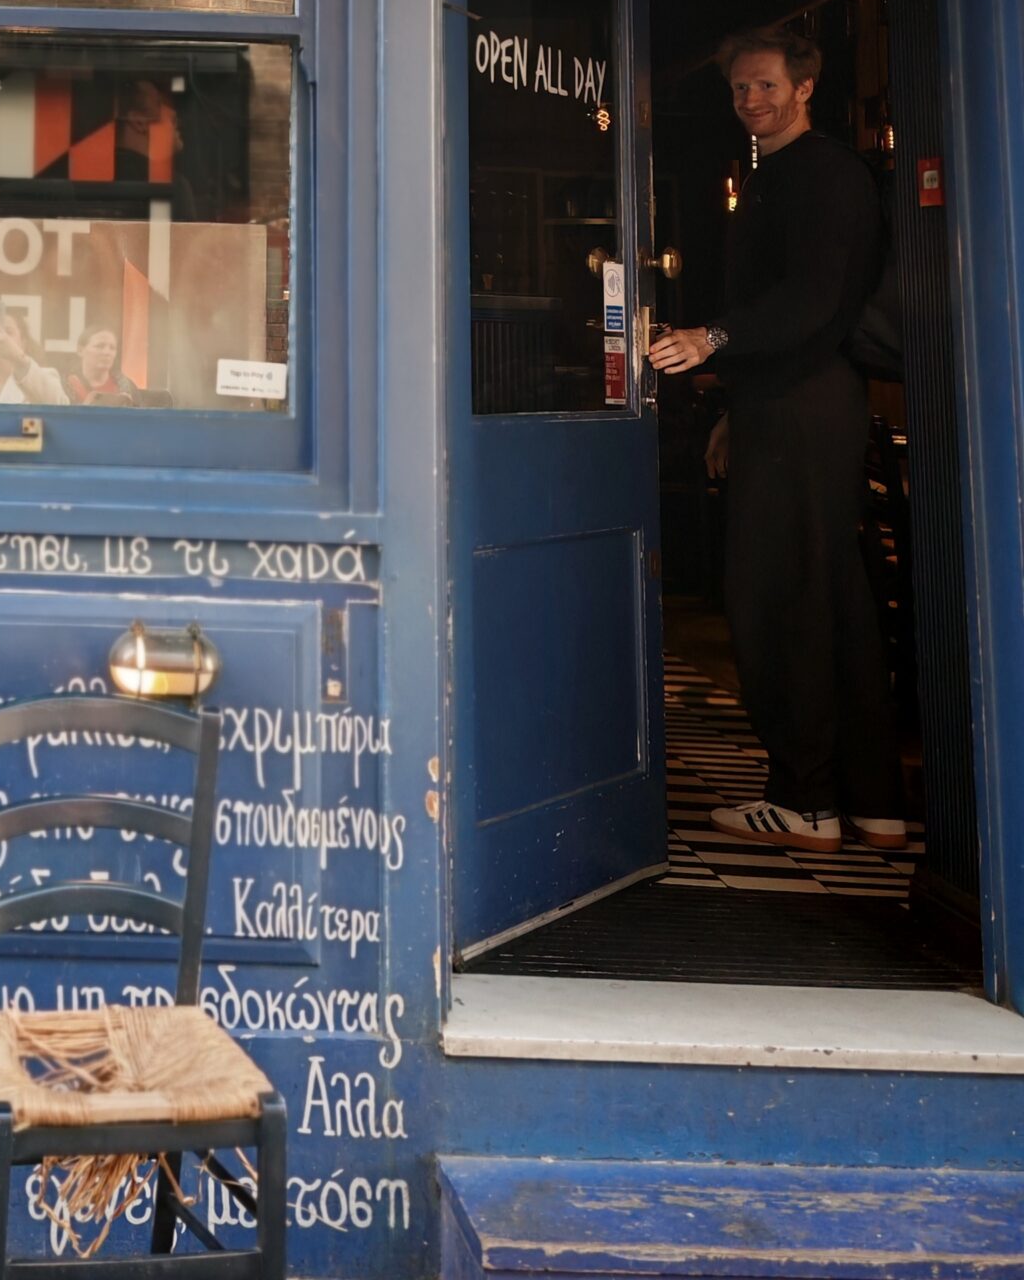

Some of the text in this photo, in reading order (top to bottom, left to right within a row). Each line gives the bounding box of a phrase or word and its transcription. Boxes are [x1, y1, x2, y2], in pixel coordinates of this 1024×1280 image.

[475, 30, 606, 107] OPEN ALL DAY
